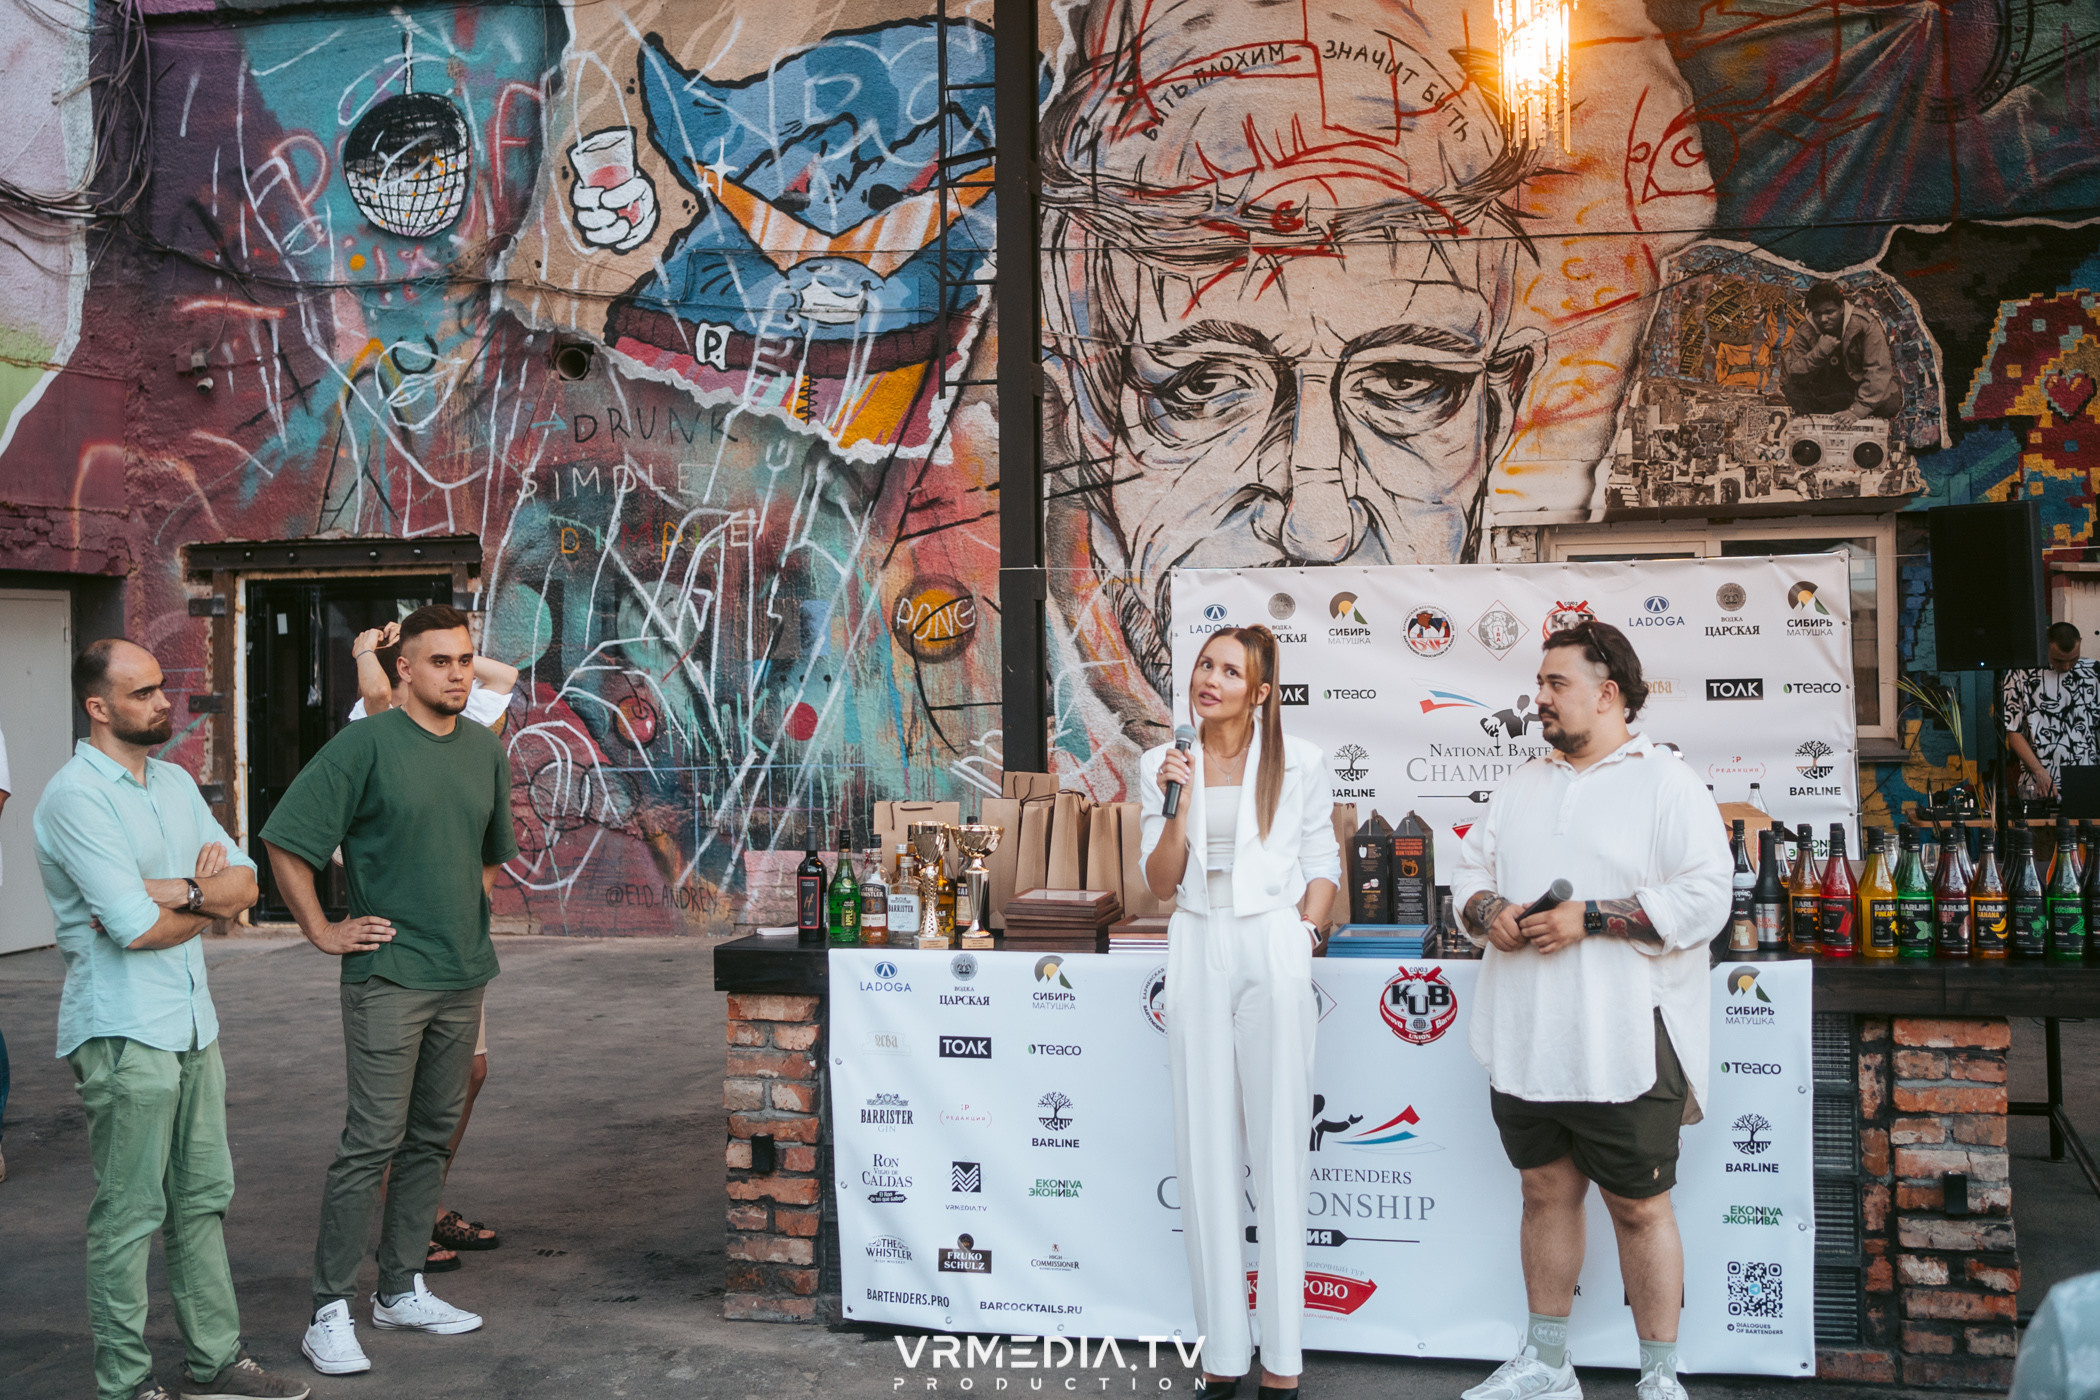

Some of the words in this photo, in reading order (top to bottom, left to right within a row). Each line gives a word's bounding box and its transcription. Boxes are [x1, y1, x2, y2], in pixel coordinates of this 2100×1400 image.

[1193, 43, 1284, 88] ПЛОХИМ
[574, 406, 738, 444] DRUNK
[896, 598, 976, 640] PONG
[1629, 616, 1685, 627] LADOGA
[1787, 618, 1833, 628] СИБИРЬ
[1328, 628, 1371, 637] СИБИРЬ
[1705, 625, 1760, 637] ЦАРСКАЯ
[1787, 628, 1833, 637] МАТУШКА
[1273, 633, 1307, 643] РСКАЯ
[1328, 637, 1371, 645] МАТУШКА
[1789, 786, 1841, 796] BARLINE
[888, 904, 914, 913] BARRISTER
[860, 981, 912, 993] LADOGA
[939, 995, 990, 1006] ЦАРСКАЯ
[1032, 991, 1076, 1002] СИБИРЬ
[1390, 984, 1451, 1016] KUB
[1032, 1001, 1076, 1011] МАТУШКА
[1726, 1006, 1775, 1016] СИБИРЬ
[1726, 1016, 1775, 1025] МАТУШКА
[860, 1109, 914, 1125] BARRISTER
[877, 1125, 896, 1133] GIN
[1031, 1137, 1080, 1148] BARLINE
[1725, 1163, 1779, 1174] BARLINE
[862, 1170, 913, 1188] CALDAS
[1309, 1167, 1413, 1185] ARTENDERS
[1036, 1179, 1082, 1189] EKONIVA
[1028, 1188, 1079, 1198] ЭКОНИВА
[1730, 1205, 1783, 1217] EKONIVA
[1722, 1214, 1779, 1226] ЭКОНИВА
[881, 1238, 897, 1248] THE
[865, 1247, 912, 1261] WHISTLER
[947, 1251, 983, 1261] FRUKO
[944, 1261, 985, 1270] SCHULZ
[1306, 1261, 1348, 1273] БОРОЧНЫЙ
[866, 1288, 950, 1308] BARTENDERS.PRO
[980, 1301, 1083, 1315] BARCOCKTAILS.RU
